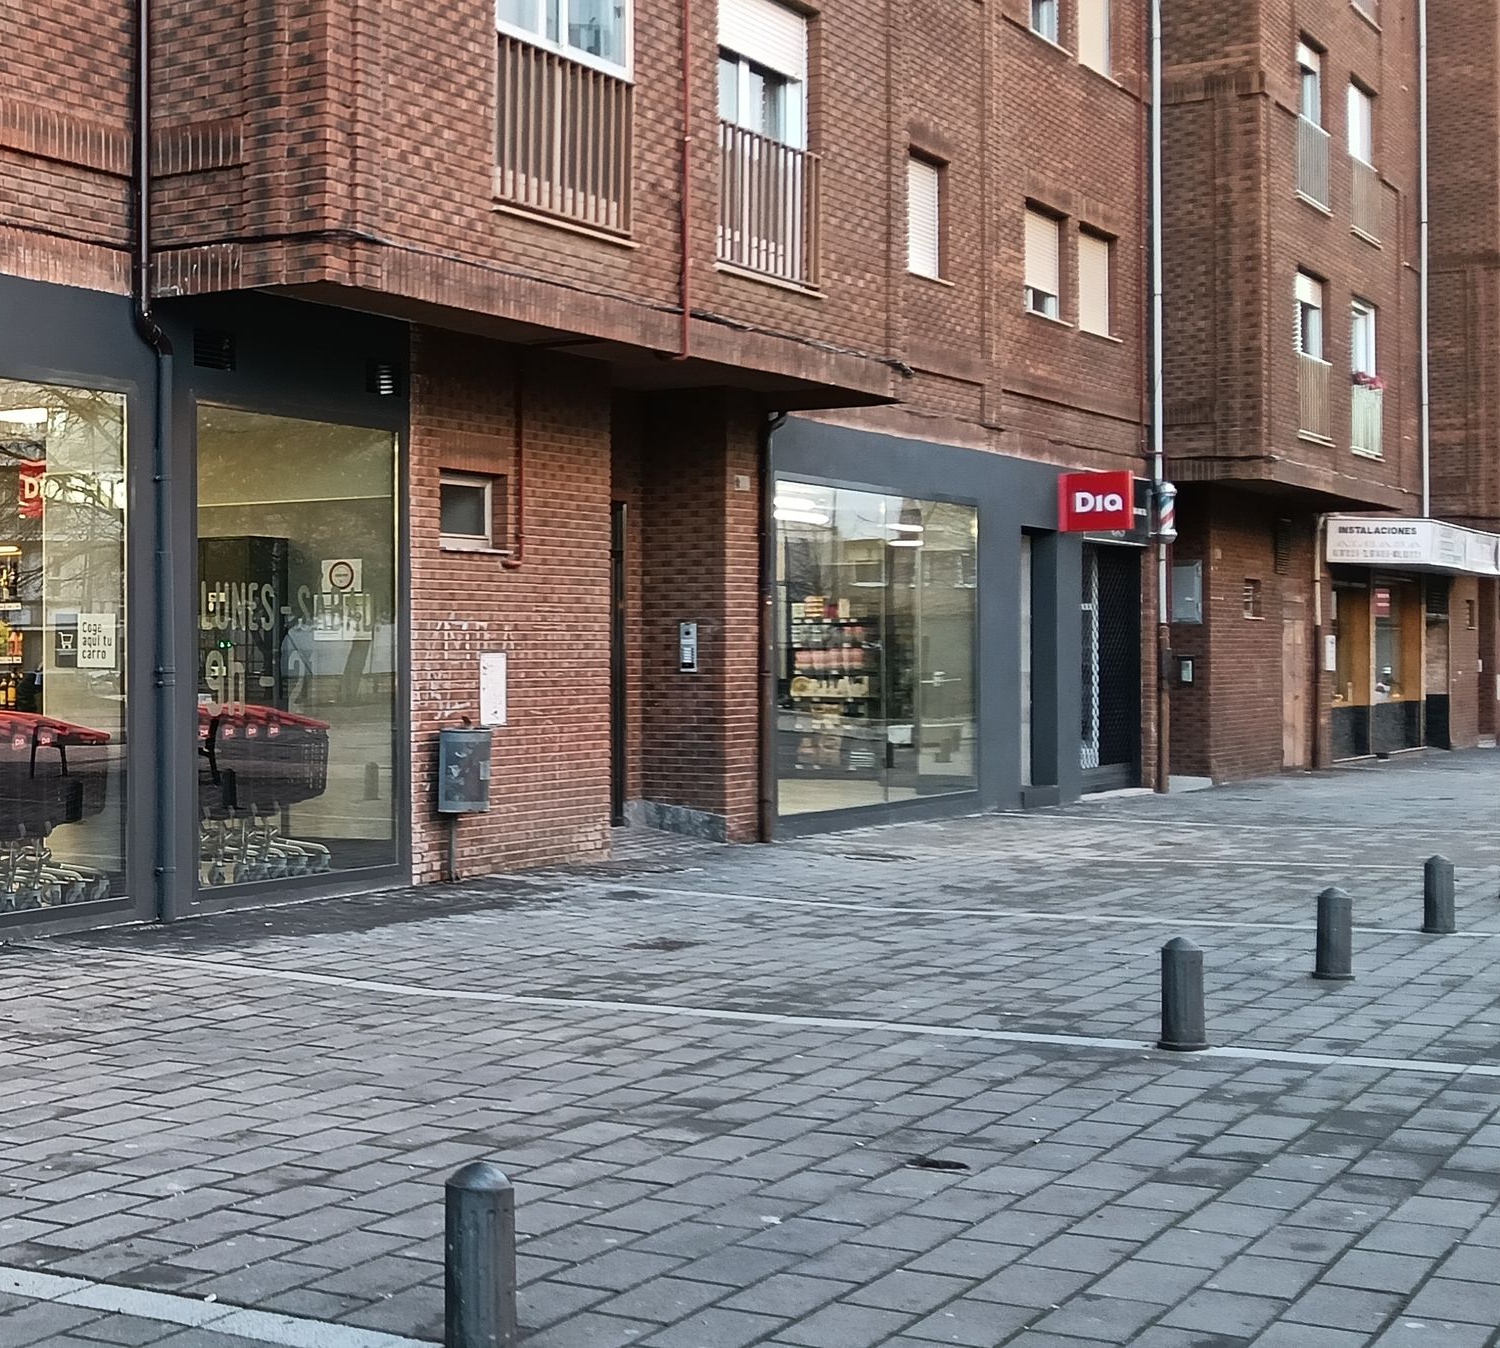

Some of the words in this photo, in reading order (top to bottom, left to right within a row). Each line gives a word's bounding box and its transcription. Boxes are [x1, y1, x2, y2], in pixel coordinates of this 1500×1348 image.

[1075, 491, 1123, 513] Dia
[1338, 526, 1418, 535] INSTALACIONES
[200, 580, 275, 632] LUNES
[82, 621, 102, 635] Coge
[103, 635, 112, 646] tu
[82, 649, 107, 659] carro
[206, 646, 246, 717] 9h
